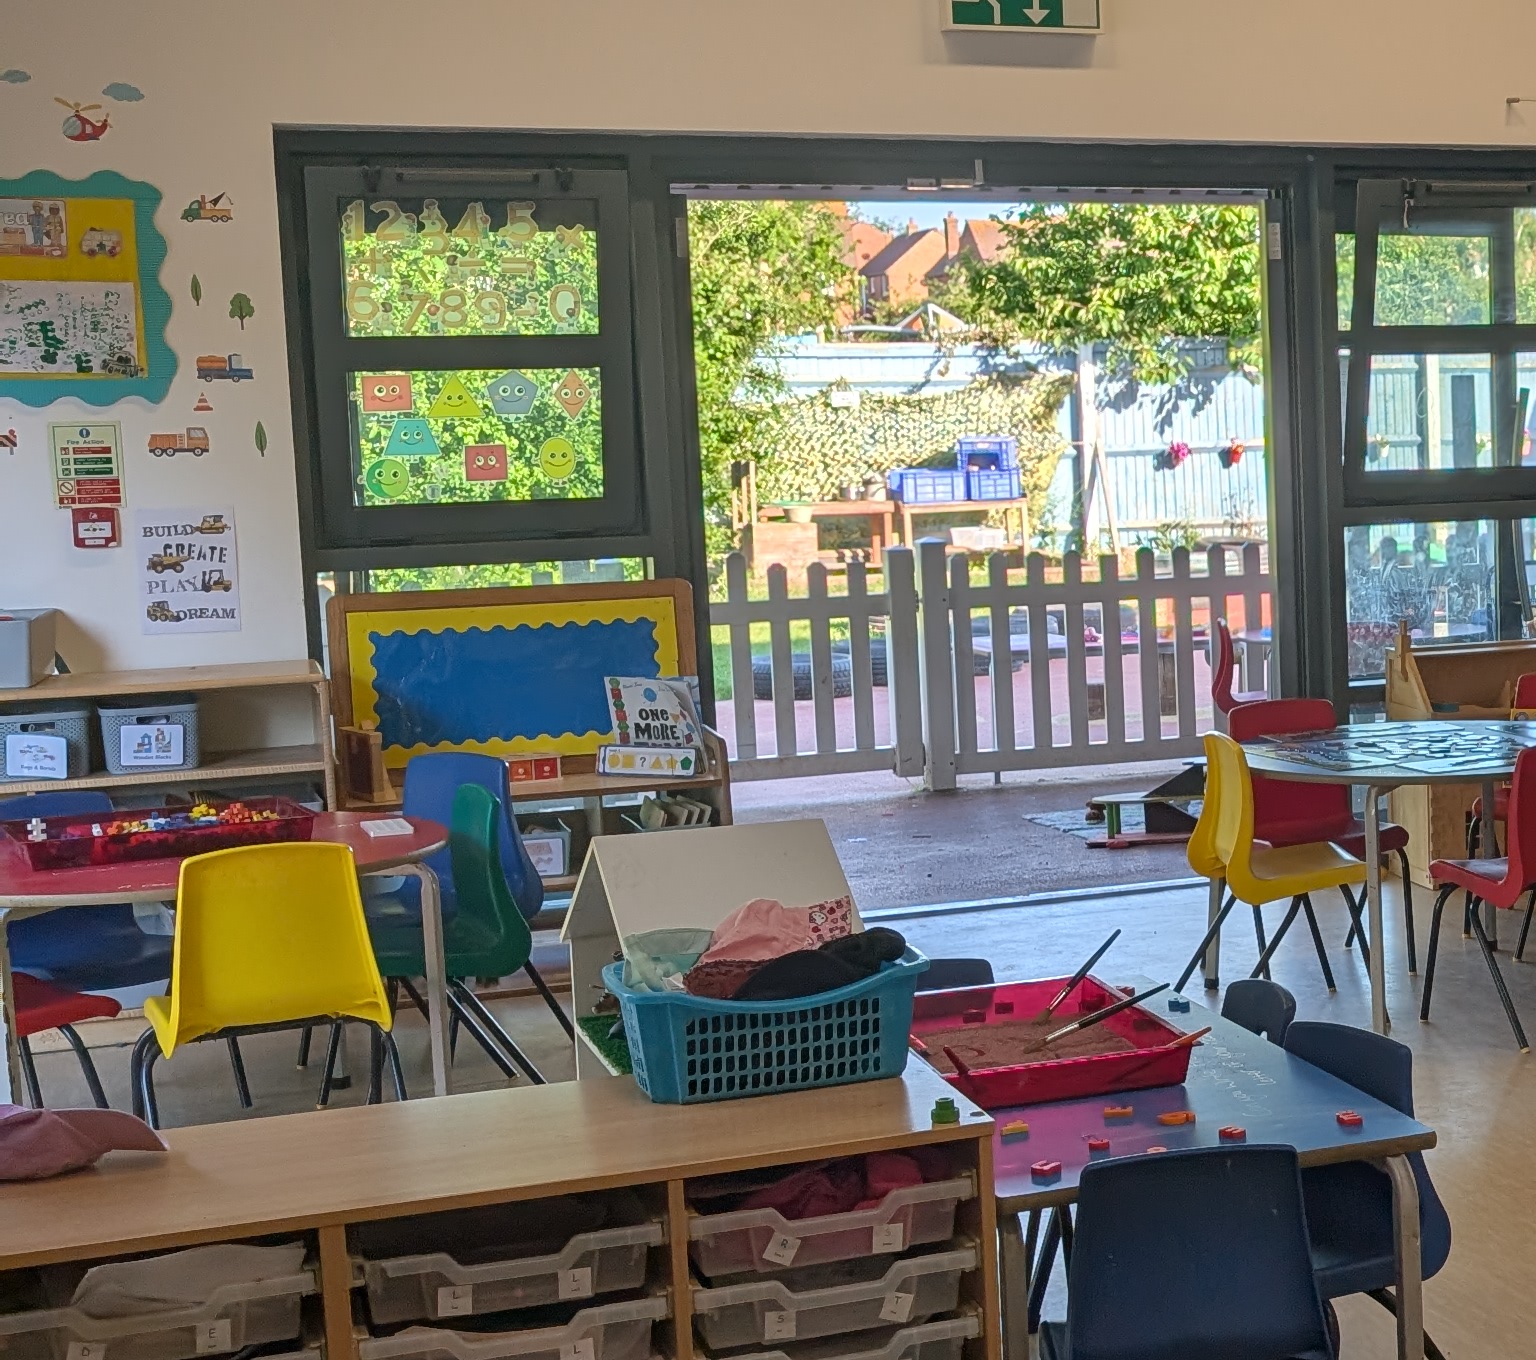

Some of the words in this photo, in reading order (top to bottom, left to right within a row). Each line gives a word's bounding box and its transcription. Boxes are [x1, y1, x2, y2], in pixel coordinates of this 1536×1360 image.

[142, 524, 195, 538] BUILD
[162, 542, 228, 564] CREATE
[146, 575, 204, 595] PLAY
[175, 607, 237, 622] DREAM
